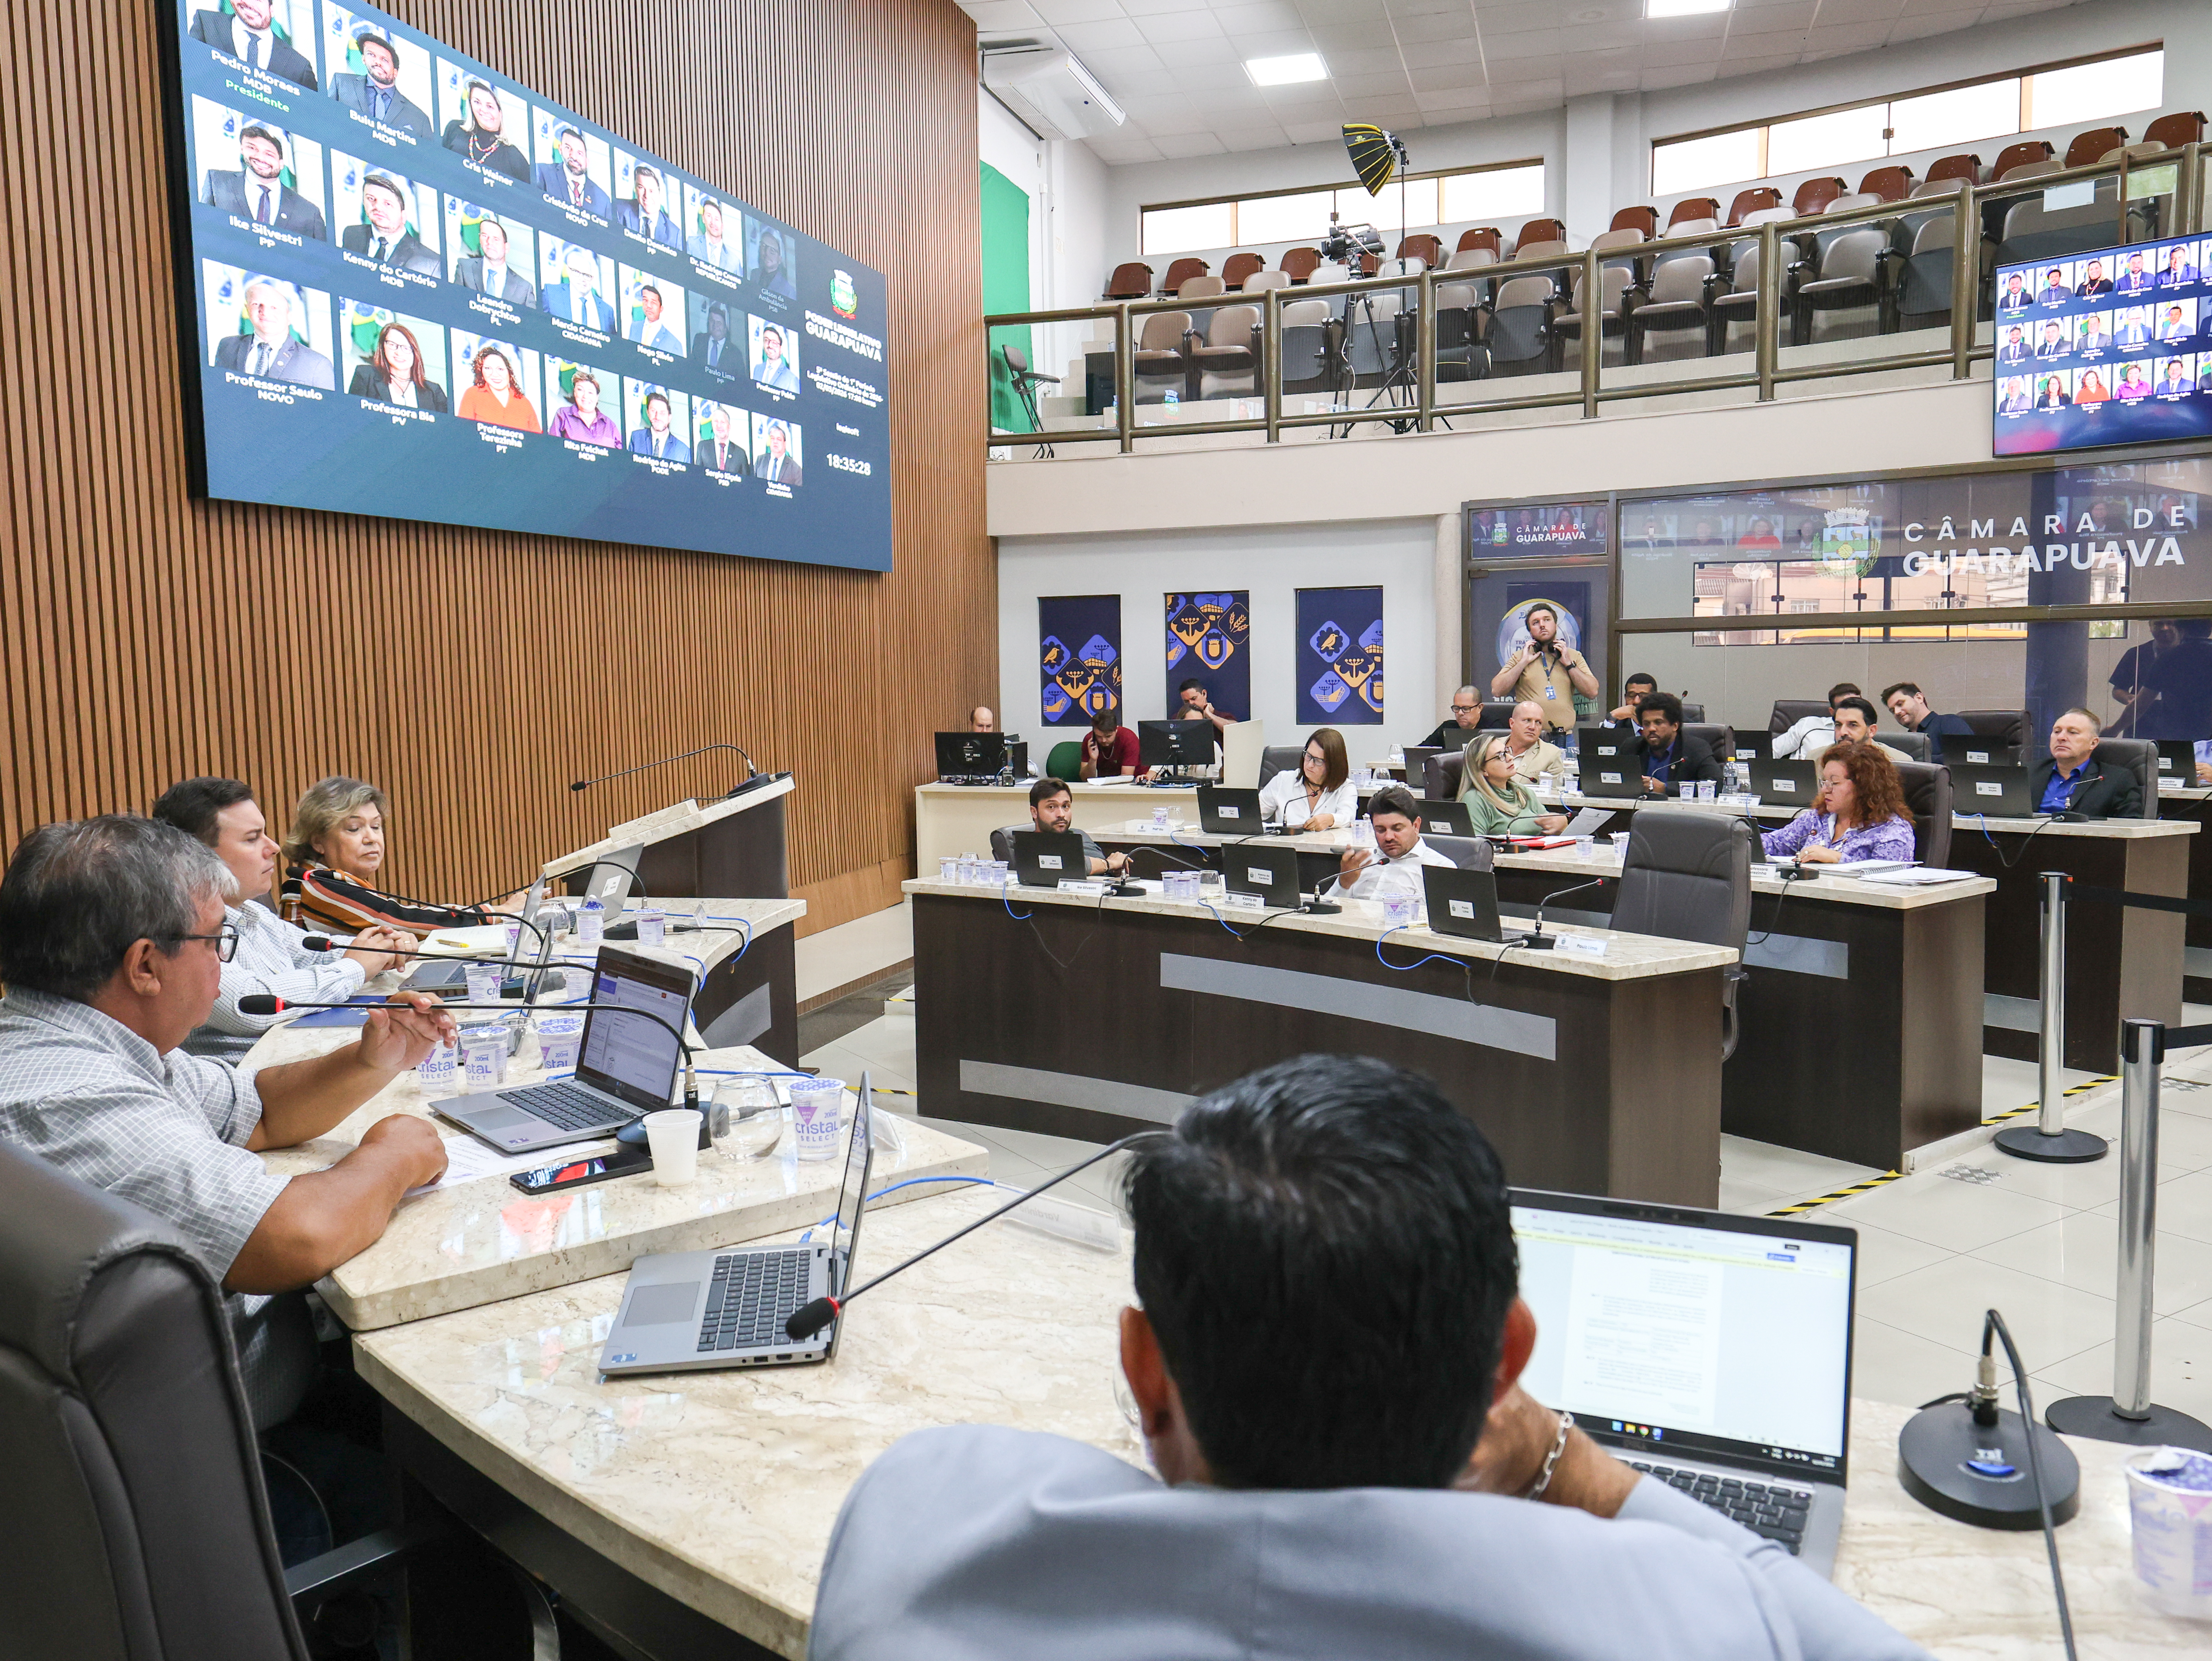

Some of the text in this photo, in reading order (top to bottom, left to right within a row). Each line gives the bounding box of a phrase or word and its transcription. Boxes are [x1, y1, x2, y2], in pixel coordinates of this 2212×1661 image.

[211, 50, 300, 95] Pedro Moraes
[243, 75, 272, 94] MDB
[225, 79, 290, 112] Presidente
[350, 109, 417, 146] Buiu Martins
[372, 130, 396, 146] MDB
[462, 159, 513, 186] Cris Wainer
[484, 177, 495, 187] PT
[542, 193, 608, 228] Cristóvão da Cruz
[566, 212, 588, 226] NOVO
[229, 215, 302, 247] Ike Silvestri
[260, 237, 275, 247] PP
[624, 228, 677, 257] Danilo Dominico
[343, 252, 437, 288] Kenny do Cartório
[380, 274, 404, 288] MDB
[477, 293, 513, 312] Leandro
[759, 294, 787, 310] Ambulância
[761, 288, 777, 299] Gilson
[469, 300, 521, 324] Dobrychtop
[490, 317, 502, 326] PL
[552, 317, 610, 343] Marcio Carneiro
[805, 310, 882, 349] PODER LEGISLATIVO
[562, 330, 602, 348] CIDADANIA
[805, 321, 882, 363] GUARAPUAVA
[637, 345, 674, 363] Nego Silvio
[652, 357, 660, 366] PL
[705, 366, 735, 381] Paulo Lima
[225, 372, 323, 401] Professor Saulo
[257, 391, 294, 405] NOVO
[360, 399, 435, 423] Professora Bia
[392, 416, 406, 426] PV
[477, 422, 524, 440] Professora
[480, 432, 522, 448] Terezinha
[496, 445, 507, 454] PT
[564, 440, 580, 451] Rita
[578, 452, 596, 461] MDB
[633, 454, 659, 467] Rodrigo
[827, 453, 871, 476] 18:35:28
[651, 467, 669, 476] PODE
[1516, 524, 1565, 533] CÂMARA
[1904, 505, 2185, 543] CÂMARA DE
[1516, 531, 1586, 543] GUARAPUAVA
[1903, 538, 2186, 578] GUARAPUAVA
[801, 1133, 835, 1142] SELECT
